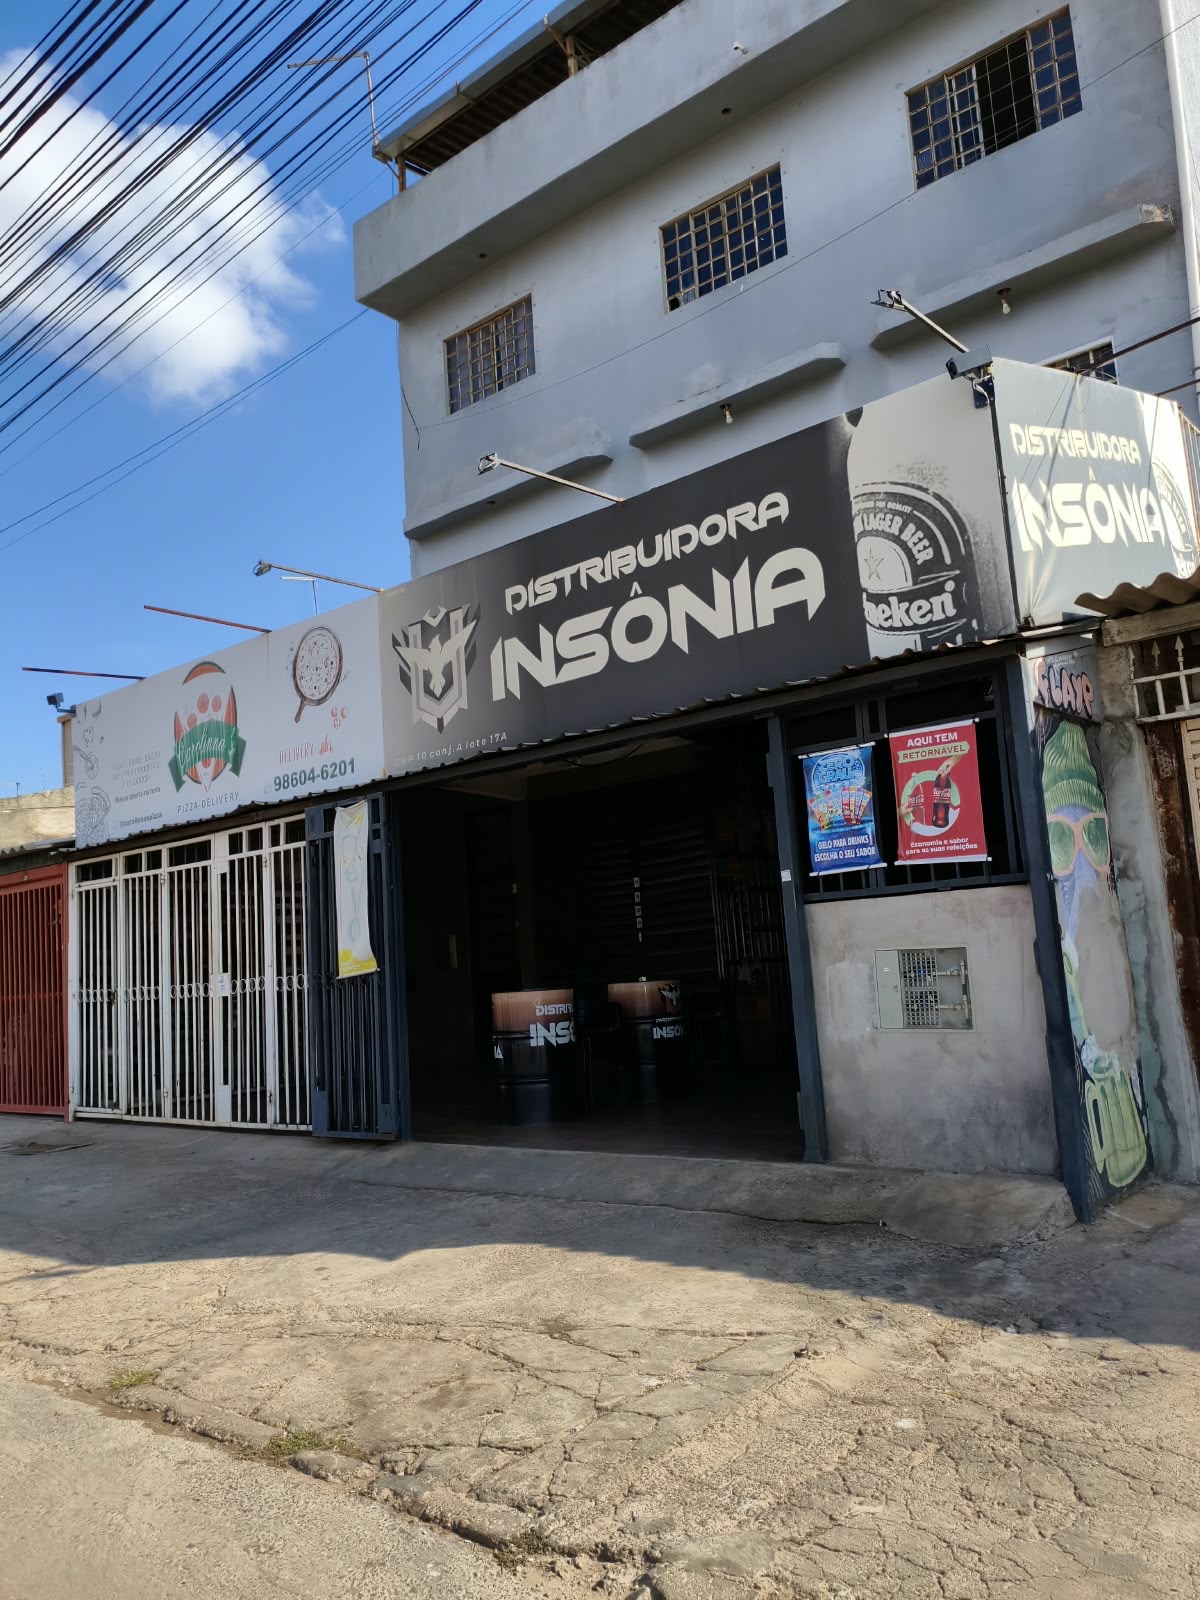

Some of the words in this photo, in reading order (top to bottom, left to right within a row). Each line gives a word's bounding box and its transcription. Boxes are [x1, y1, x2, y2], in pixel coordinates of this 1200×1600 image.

[1009, 423, 1142, 468] DISTRIBUIDORA
[1010, 467, 1166, 555] INSÔNIA
[504, 491, 790, 616] DISTRIBUIDORA
[900, 522, 934, 566] BEER
[489, 546, 826, 702] INSÔNIA
[416, 751, 427, 762] 10
[429, 744, 455, 759] conj.
[456, 743, 463, 752] A
[465, 738, 487, 750] lote
[489, 732, 508, 744] 17A
[906, 733, 933, 748] AQUI
[934, 731, 958, 743] TEM
[279, 742, 314, 765] DELIVERY
[902, 744, 966, 761] RETORNÁVEL
[273, 757, 355, 792] 98604-6201
[150, 785, 161, 794] hora
[177, 791, 240, 814] PIZZA-DELIVERY
[817, 840, 833, 850] GELO
[832, 837, 847, 848] PARA
[847, 834, 869, 846] DRINKS
[905, 848, 921, 856] para
[946, 843, 978, 852] refeições
[911, 839, 943, 848] Economia
[949, 837, 969, 845] sabor
[814, 851, 838, 862] ESCOLHA
[838, 850, 844, 859] O
[844, 849, 856, 859] SEU
[855, 846, 876, 857] SABOR
